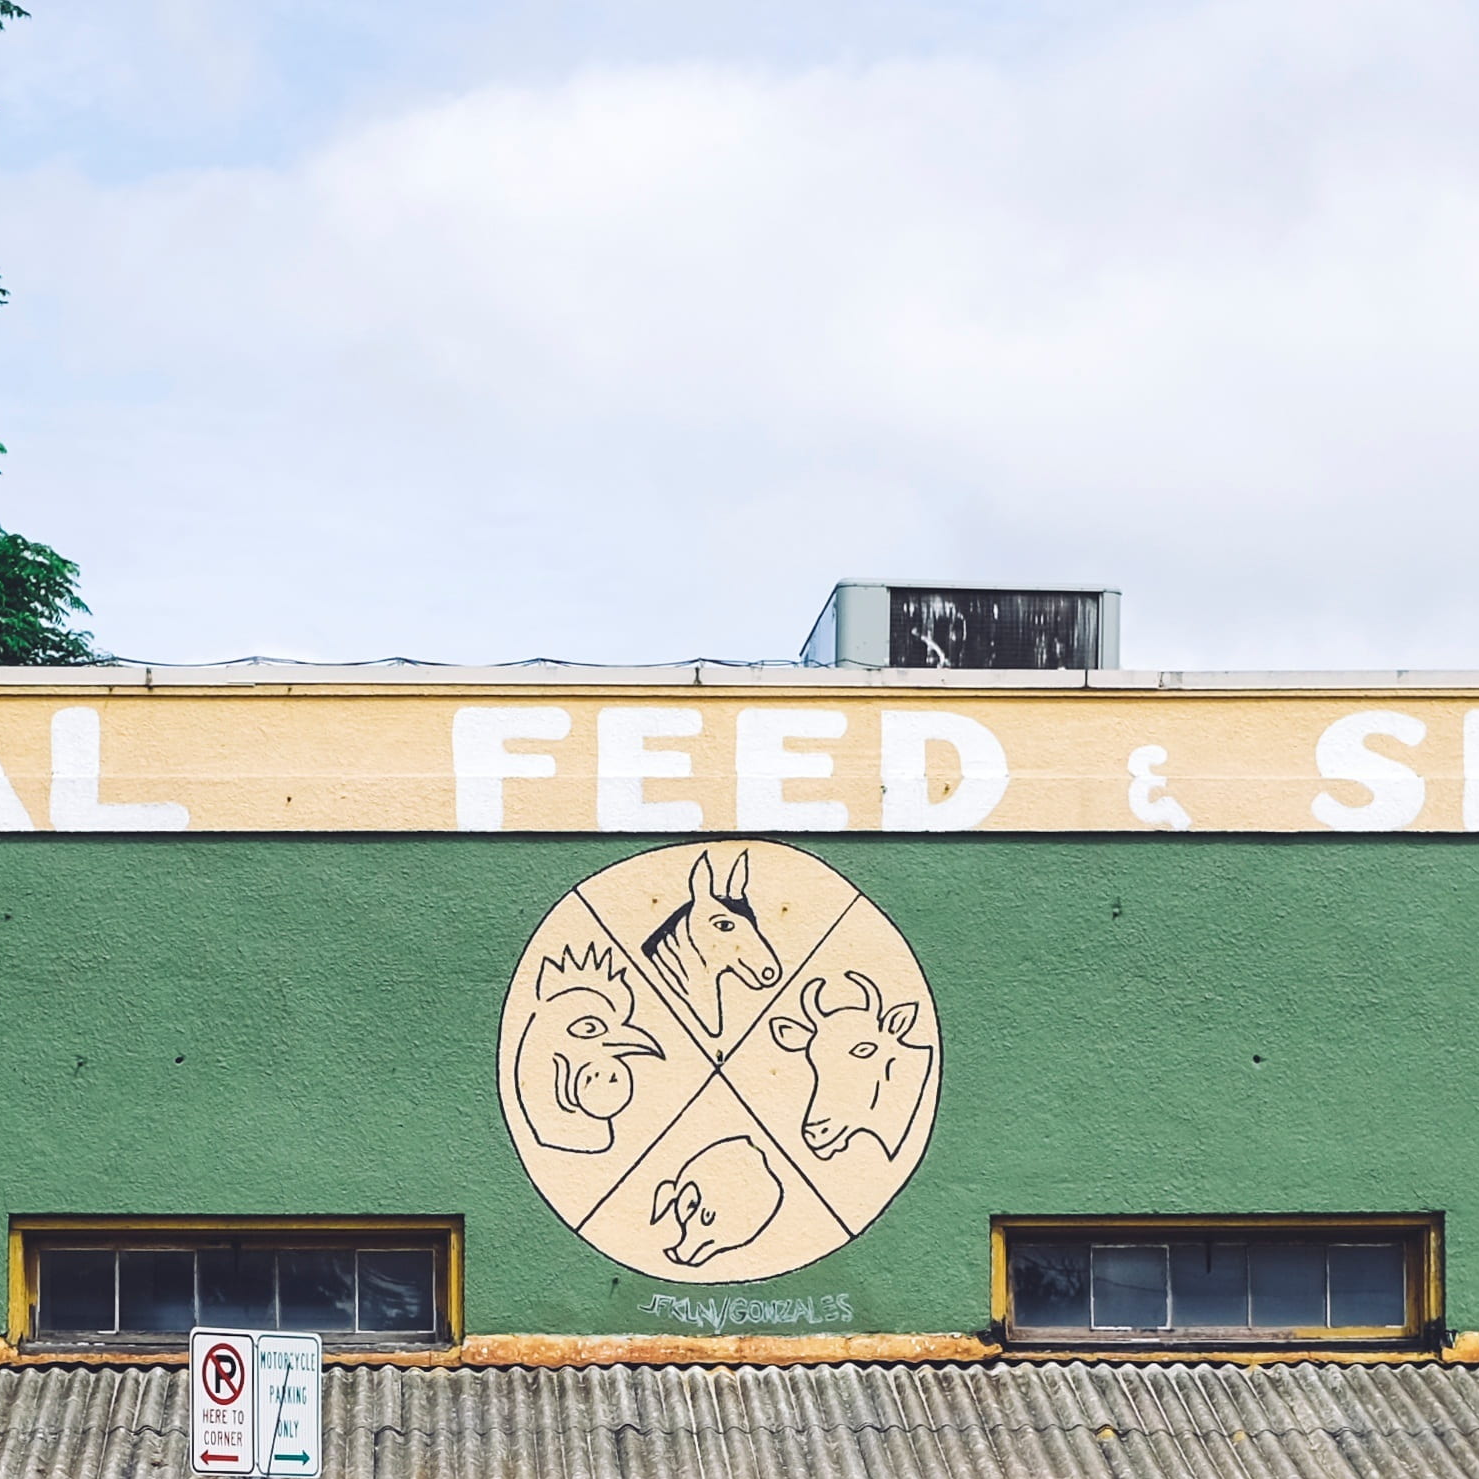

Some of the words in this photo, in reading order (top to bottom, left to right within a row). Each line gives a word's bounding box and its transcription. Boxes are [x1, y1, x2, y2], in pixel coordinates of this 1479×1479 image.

[452, 705, 1009, 834] FEED
[1126, 743, 1192, 831] &
[260, 1351, 316, 1371] MOTORCYCLE
[270, 1385, 307, 1405] PARKING
[203, 1409, 227, 1424] HERE
[233, 1411, 245, 1425] TO
[204, 1431, 243, 1446] CORNER
[278, 1420, 299, 1438] ONLY
